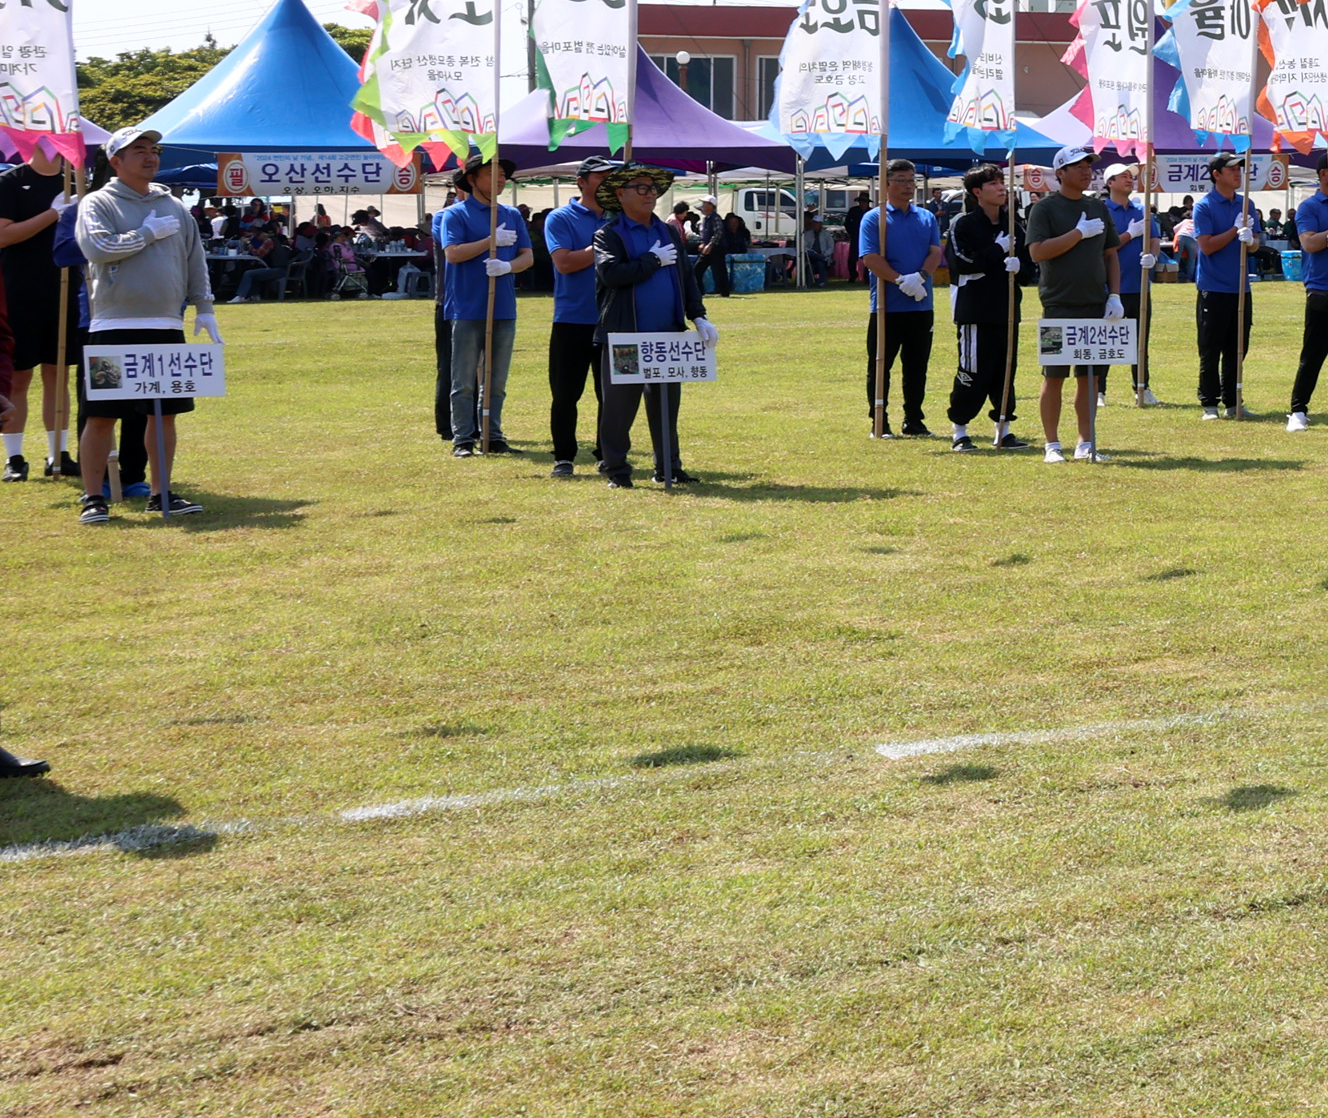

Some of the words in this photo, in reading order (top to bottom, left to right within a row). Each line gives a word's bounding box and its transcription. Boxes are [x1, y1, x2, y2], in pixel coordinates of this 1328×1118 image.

[229, 168, 244, 187] 필
[260, 162, 383, 184] 오산선수단
[397, 167, 411, 184] 승
[1270, 166, 1282, 182] 승
[1066, 325, 1130, 346] 금계2선수단
[640, 340, 706, 363] 향동선수단
[1098, 348, 1126, 360] 금호도
[170, 380, 197, 394] 용호
